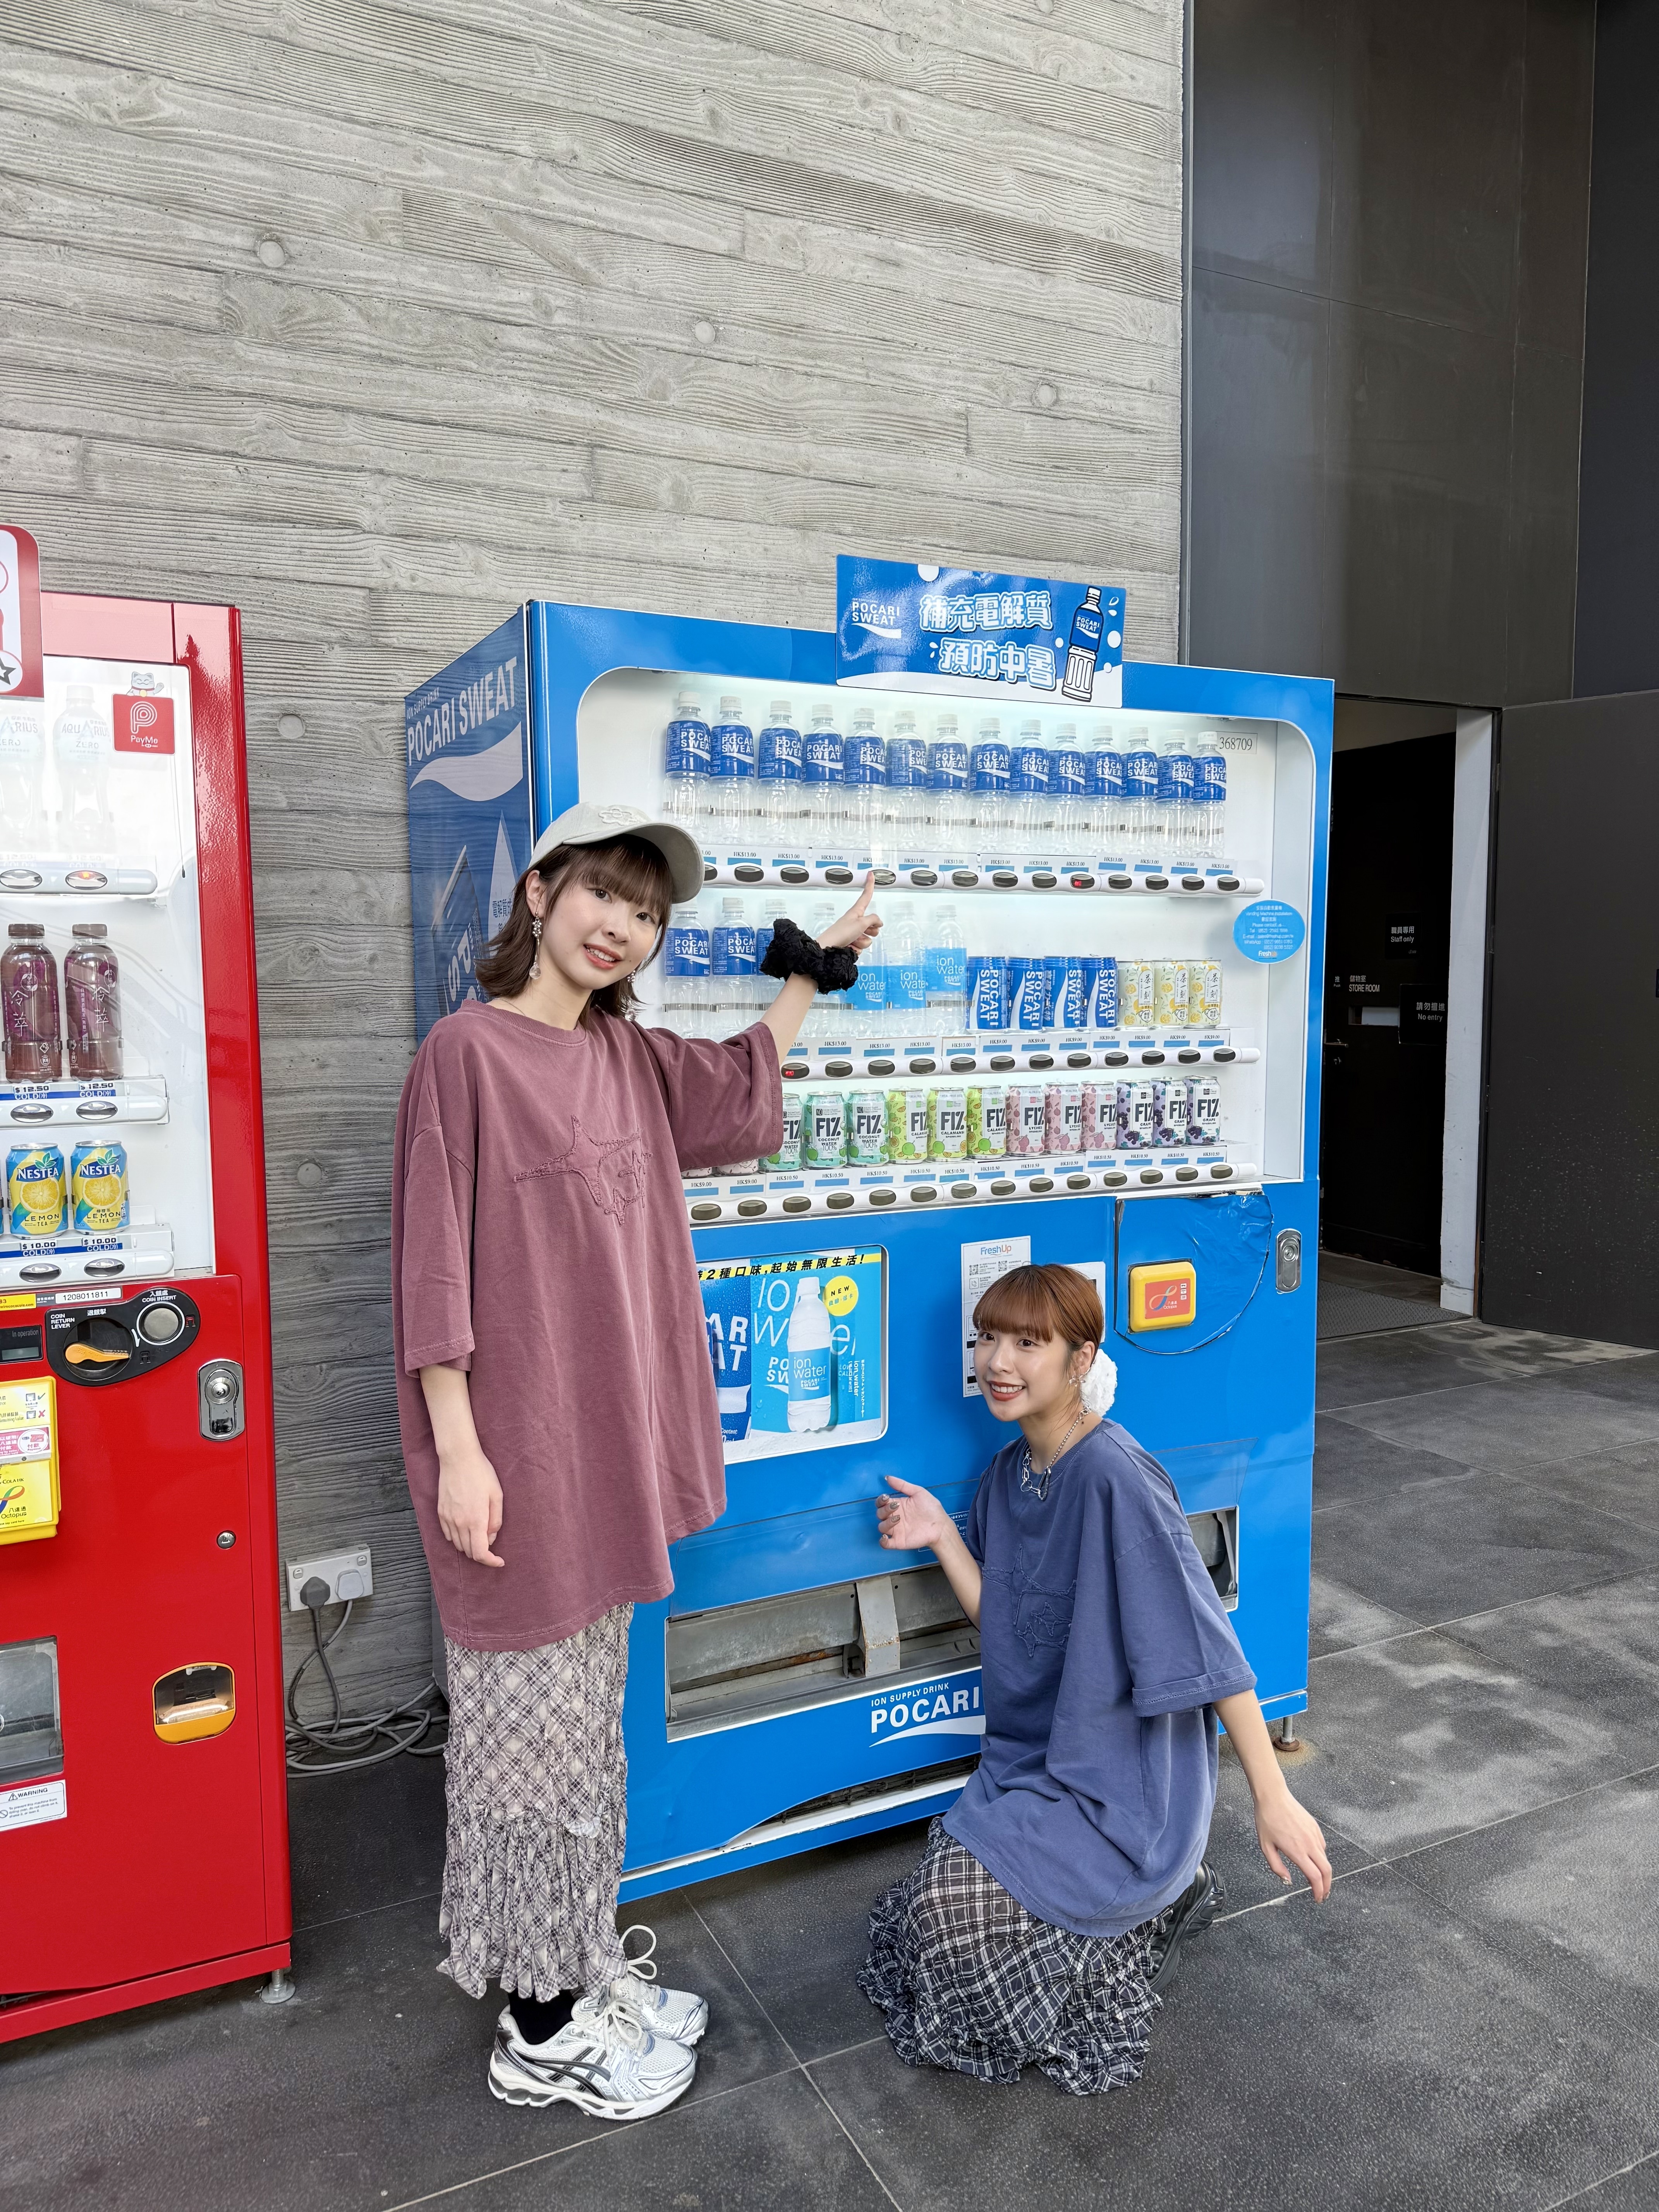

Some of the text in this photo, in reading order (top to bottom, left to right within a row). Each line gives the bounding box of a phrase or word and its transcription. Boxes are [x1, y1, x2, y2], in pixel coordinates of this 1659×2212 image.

[852, 602, 900, 617] POCARI
[920, 591, 1052, 632] 補充電解質
[852, 612, 895, 626] SWEAT
[1076, 617, 1100, 628] POCARI
[1075, 622, 1097, 632] SWEAT
[939, 638, 1056, 690] 預防中暑
[414, 696, 427, 714] SUPPLY
[428, 687, 440, 705] DRINK
[408, 656, 517, 766] POCARI SWEAT
[131, 735, 158, 745] PayMe
[1219, 737, 1253, 751] 368709
[807, 744, 842, 752] POCARI
[807, 752, 840, 760] SWEAT
[977, 761, 1009, 769] SWEAT
[1127, 768, 1158, 776] SWEAT
[675, 946, 709, 956] SWEAT
[937, 955, 954, 966] ion
[900, 970, 917, 981] ion
[936, 964, 965, 974] water
[980, 969, 990, 1020] SWEAT
[980, 969, 990, 1020] SWEAT
[990, 970, 999, 1026] POCARI
[990, 970, 999, 1026] POCARI
[1023, 971, 1036, 1022] SWEAT
[1032, 972, 1042, 1026] POCARI
[1067, 970, 1076, 1019] SWEAT
[1099, 969, 1108, 1019] SWEAT
[1416, 1002, 1445, 1011] 請勿擅進
[1427, 1013, 1442, 1022] entry
[1197, 1098, 1219, 1118] FIZ
[941, 1111, 965, 1131] FIZ
[987, 1108, 1005, 1128] FIZ
[1024, 1107, 1044, 1126] FIZ
[816, 1117, 841, 1137] FIZ
[857, 1115, 881, 1134] FIZ
[18, 1168, 59, 1180] NESTEA
[81, 1164, 121, 1176] NESTEA
[25, 1213, 59, 1221] LEMON
[981, 1244, 1012, 1255] FreshUp
[63, 1291, 108, 1300] 1208011811
[831, 1285, 850, 1296] NEW
[18, 1329, 39, 1338] operation
[794, 1357, 811, 1369] ion
[794, 1365, 826, 1379] water
[871, 1682, 949, 1707] ION SUPPLY DRINK
[871, 1686, 979, 1733] POCARI
[18, 1788, 48, 1798] WARNING
